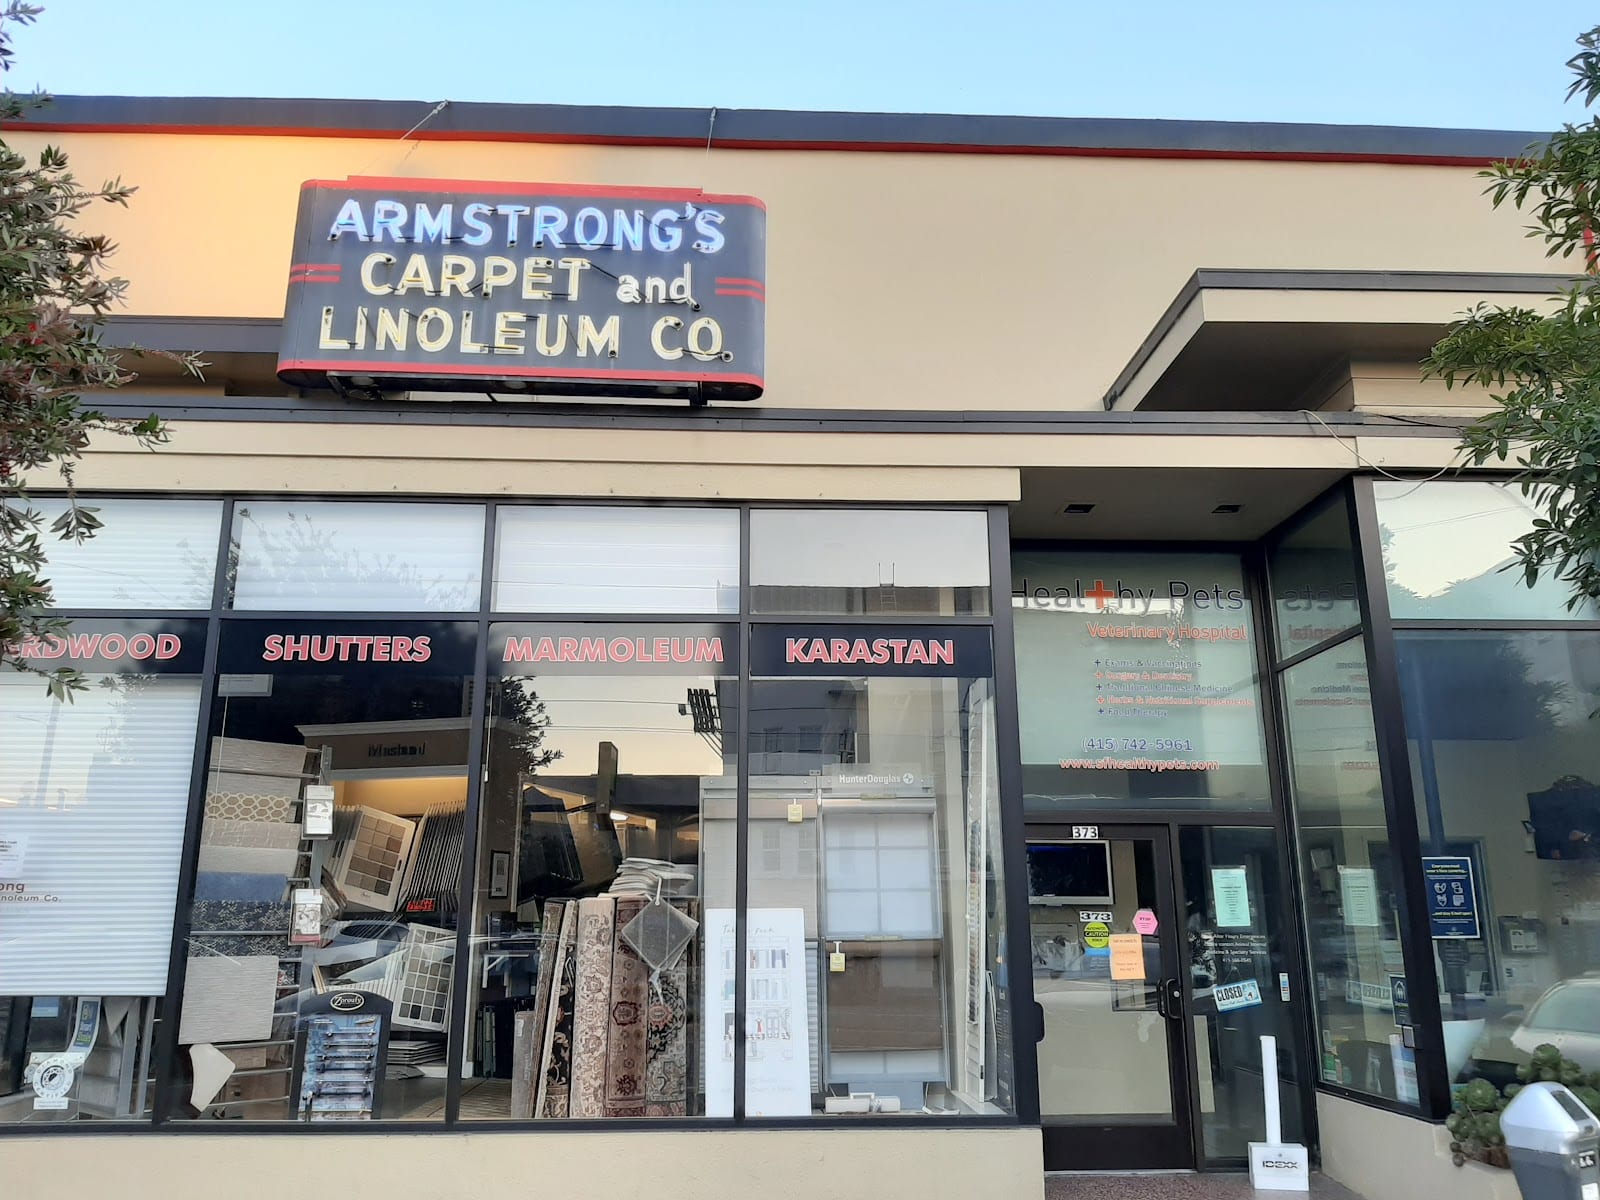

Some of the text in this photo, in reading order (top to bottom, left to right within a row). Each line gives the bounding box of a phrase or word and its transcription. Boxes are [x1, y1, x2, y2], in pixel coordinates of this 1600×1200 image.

[328, 199, 725, 254] ARMSTRONG'S
[361, 252, 692, 304] CARPET and
[319, 306, 734, 362] LINOLEUM CO.
[1168, 580, 1244, 611] Pets
[1087, 622, 1248, 643] Veterinary Hospital
[263, 634, 431, 663] SHUTTERS
[502, 637, 724, 662] MARMOLEUM
[786, 638, 954, 664] KARASTAN
[1136, 659, 1144, 667] &
[1193, 685, 1233, 693] Medicine
[1082, 737, 1193, 752] (415) 742-5961
[1059, 756, 1220, 773] www.sfhealthypets.com
[1073, 826, 1098, 839] 373
[1081, 912, 1111, 920] 373
[1216, 985, 1243, 1002] CLOSED
[1262, 1160, 1298, 1169] IDEXX
